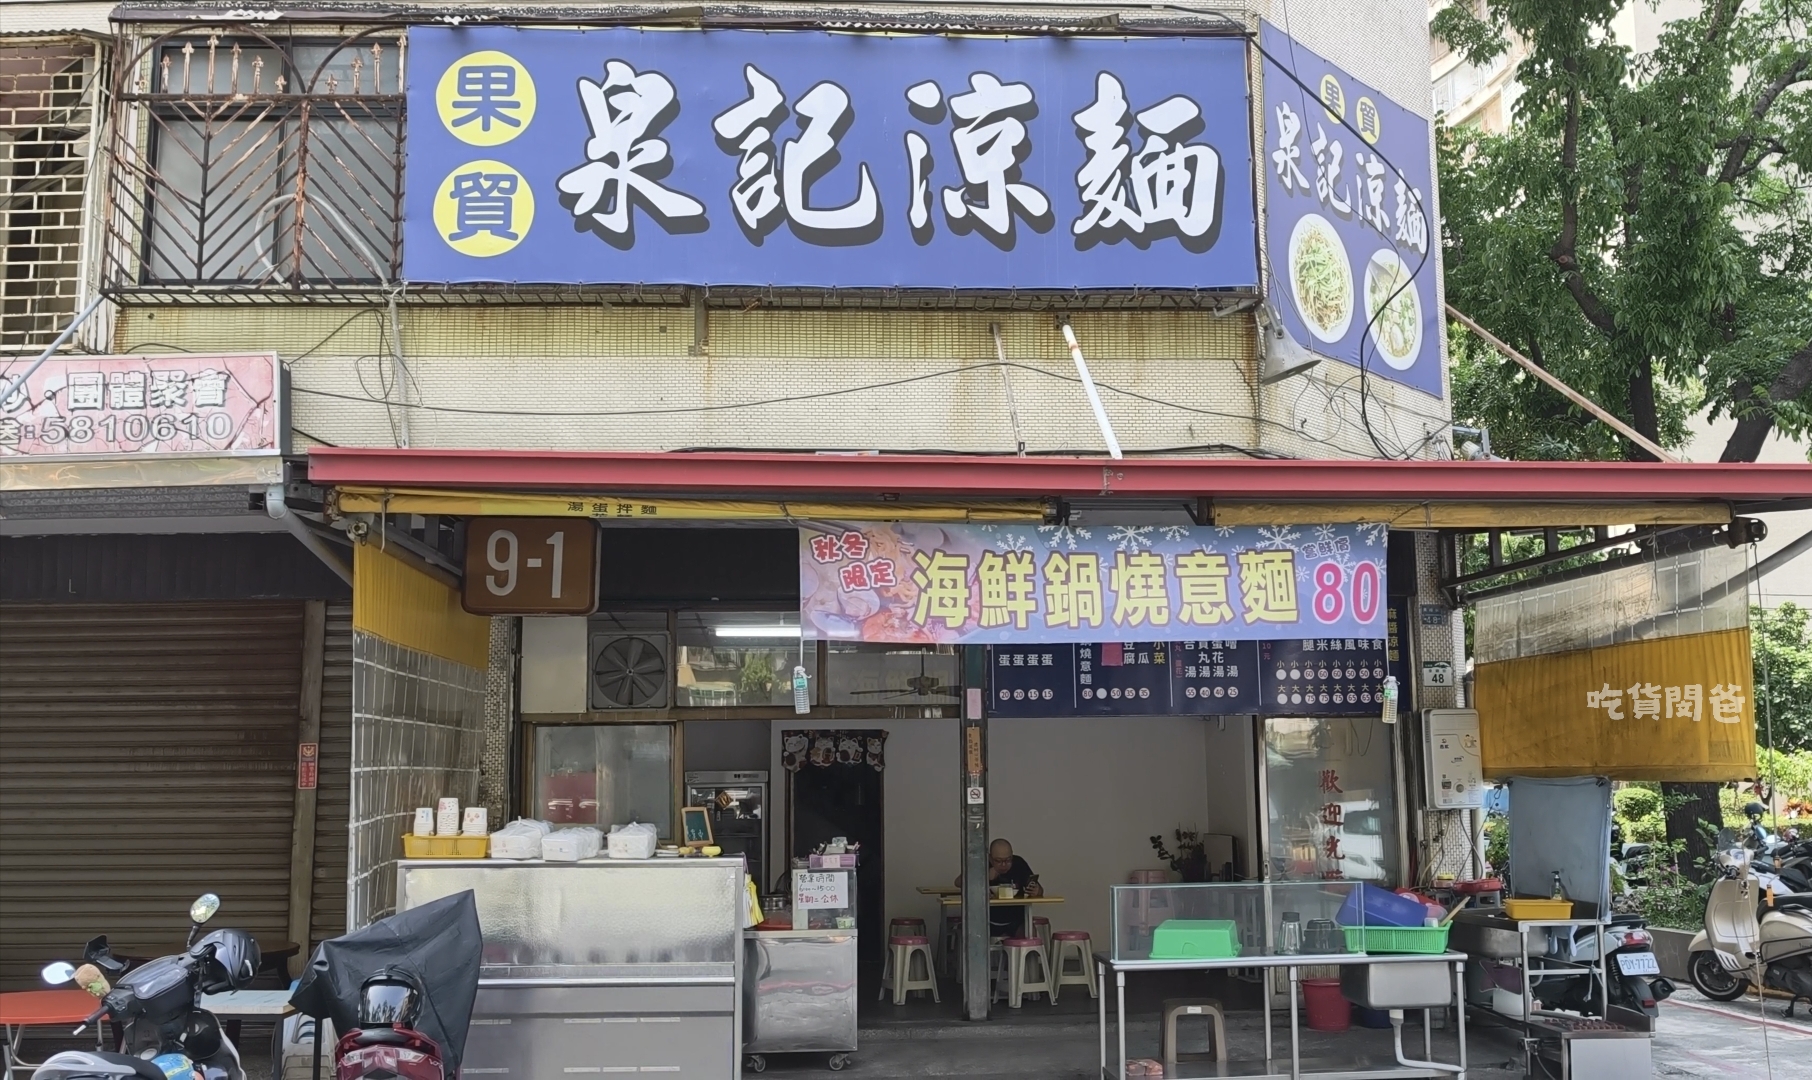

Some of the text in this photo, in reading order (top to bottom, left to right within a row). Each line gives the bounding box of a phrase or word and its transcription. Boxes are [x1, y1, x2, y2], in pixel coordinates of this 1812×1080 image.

[1324, 80, 1376, 139] 果貿
[449, 64, 521, 241] 果貿
[557, 60, 1220, 244] 泉記涼麵
[1272, 101, 1427, 254] 泉記涼麵
[486, 529, 564, 598] 9-1
[812, 532, 868, 562] 秋冬
[841, 561, 896, 591] 限定
[912, 550, 1299, 628] 海鮮鍋燒意麵
[1313, 561, 1380, 624] 80
[1432, 673, 1444, 684] 48
